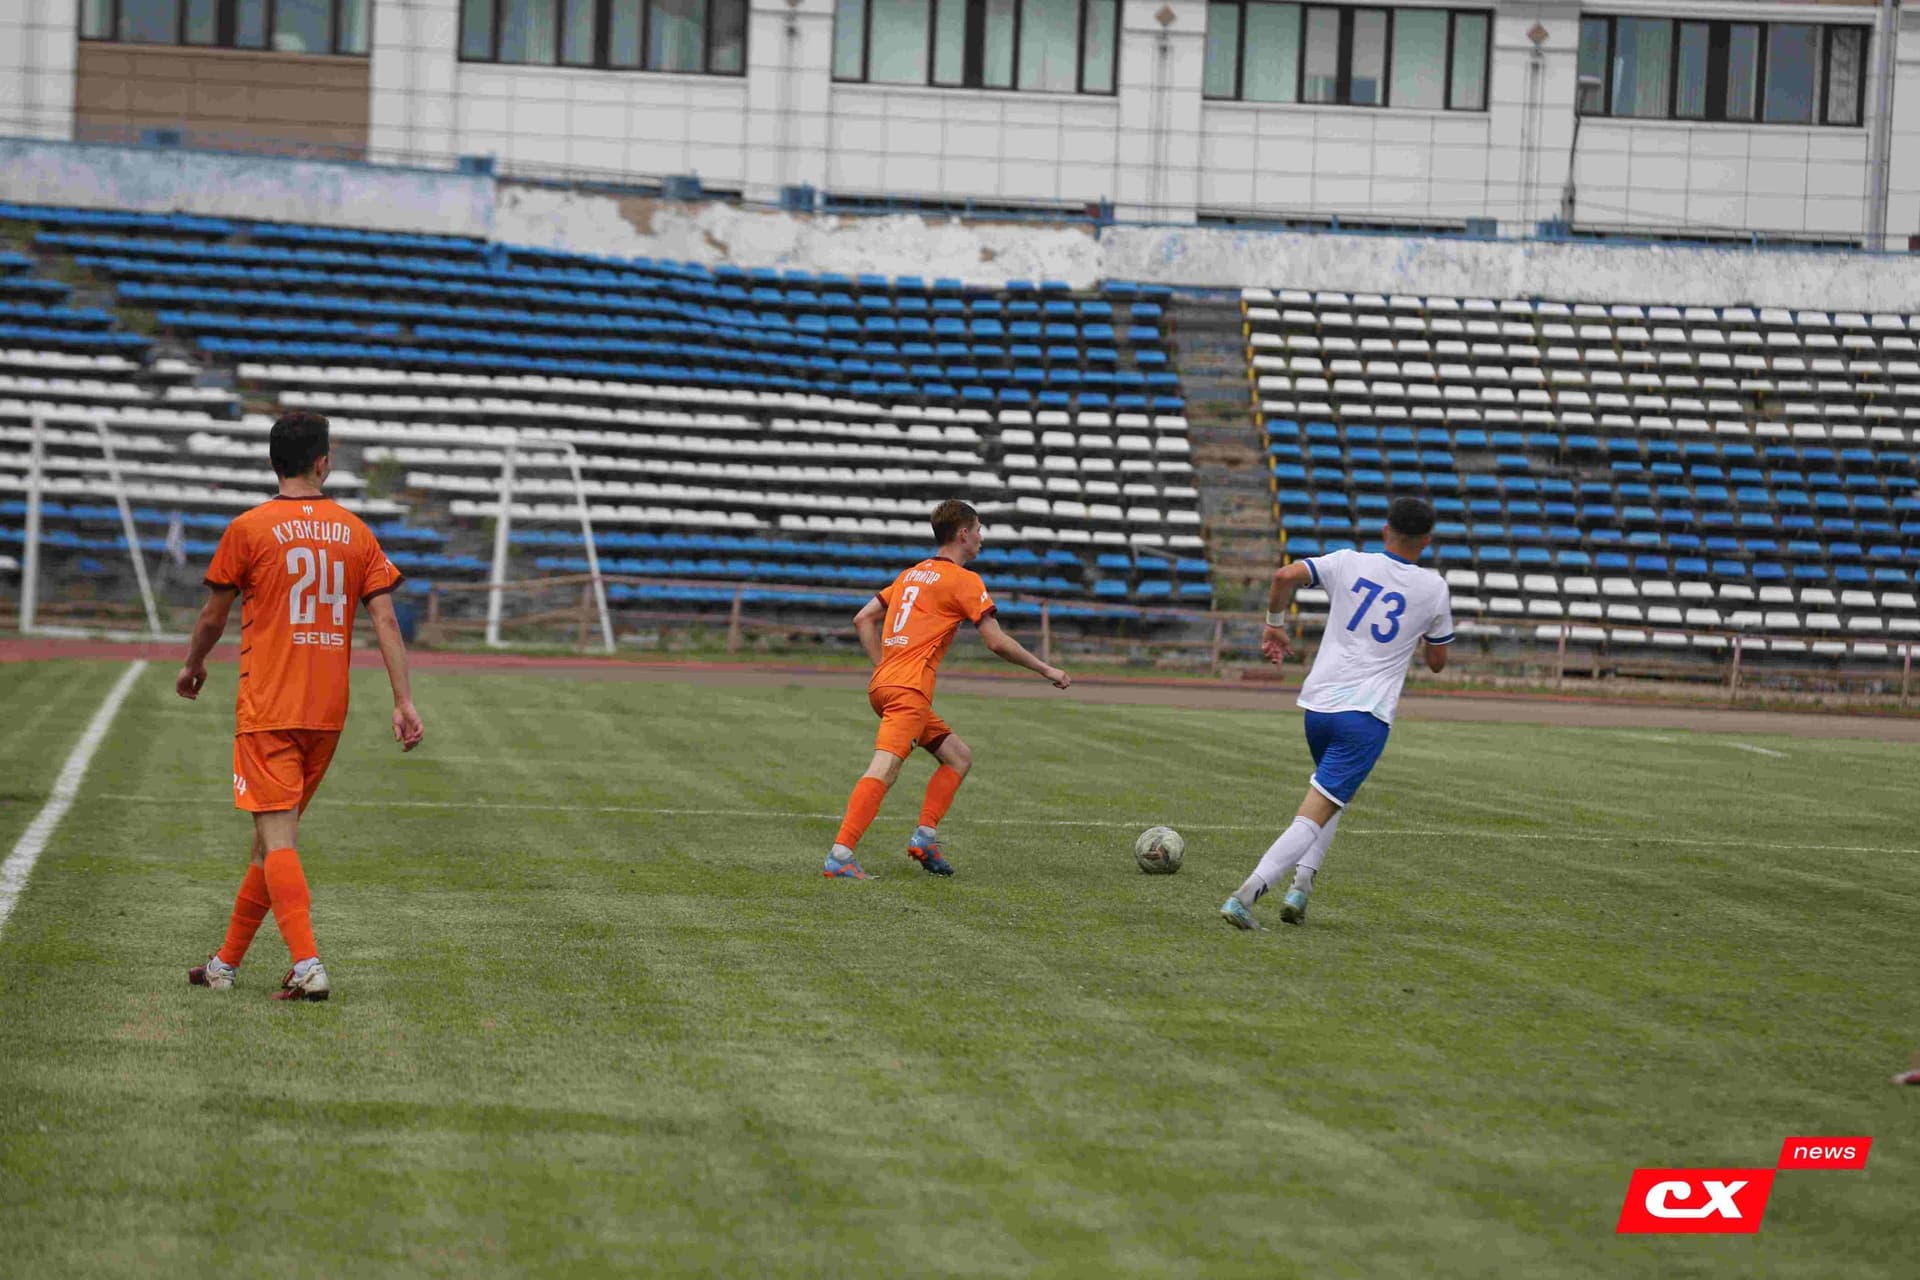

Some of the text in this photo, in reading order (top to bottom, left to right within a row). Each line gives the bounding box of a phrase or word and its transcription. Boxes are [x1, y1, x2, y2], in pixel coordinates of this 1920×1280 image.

[272, 519, 351, 545] КУЗНЕЦОВ
[286, 546, 347, 626] 24
[893, 585, 920, 633] 3
[1346, 576, 1407, 644] 73
[292, 631, 345, 645] SEUS
